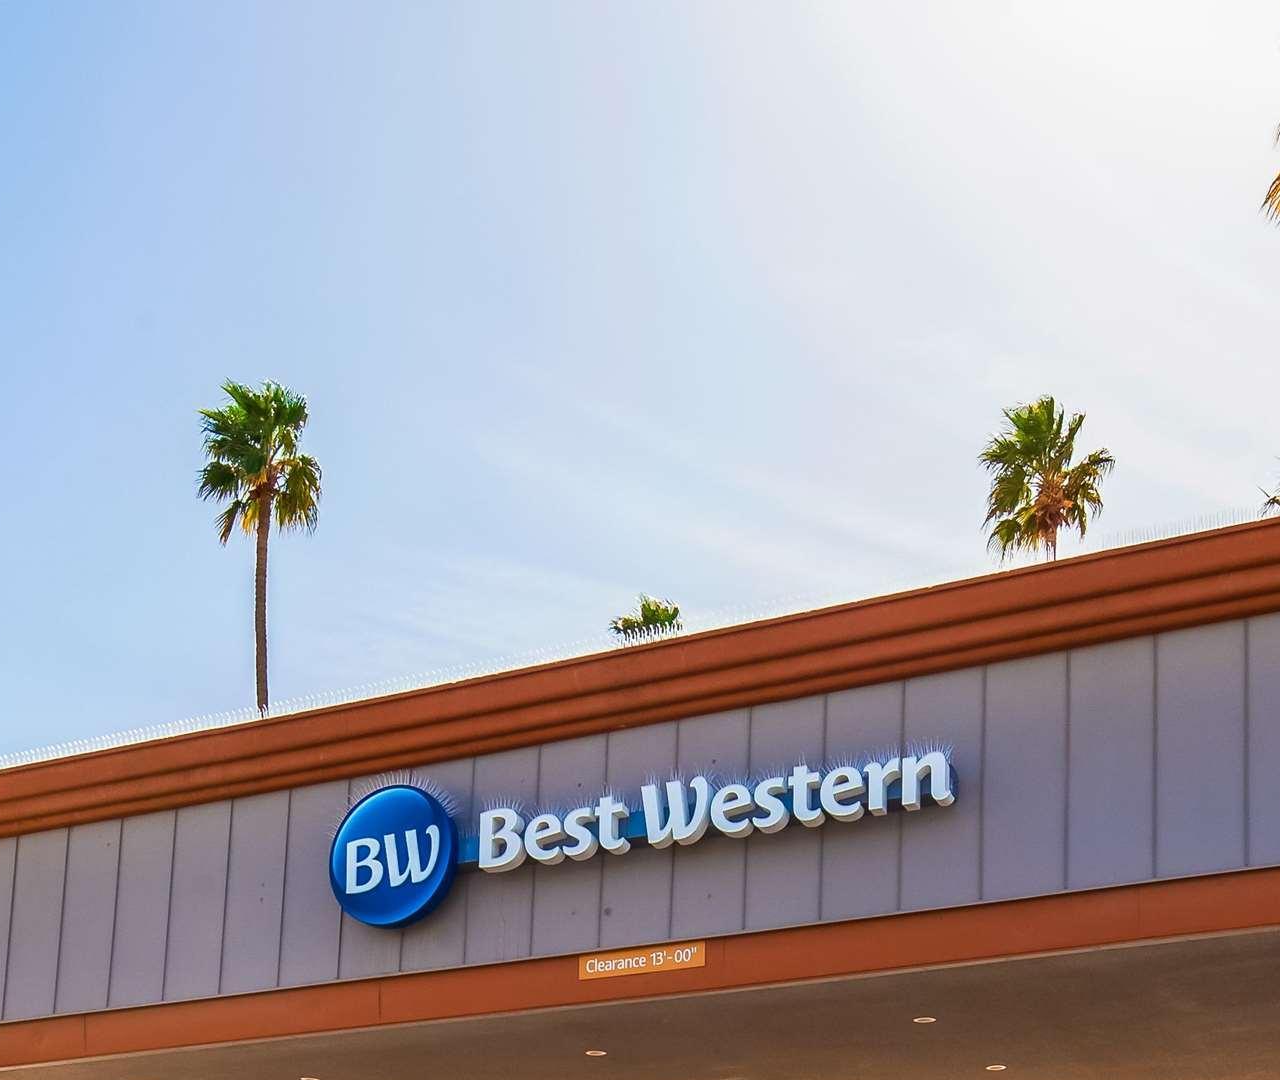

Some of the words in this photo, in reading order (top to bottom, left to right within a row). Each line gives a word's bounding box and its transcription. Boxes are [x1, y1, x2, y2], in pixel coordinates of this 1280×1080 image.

[478, 796, 631, 873] Best
[641, 751, 955, 849] Western
[345, 825, 440, 895] BW
[586, 956, 646, 973] Clearance
